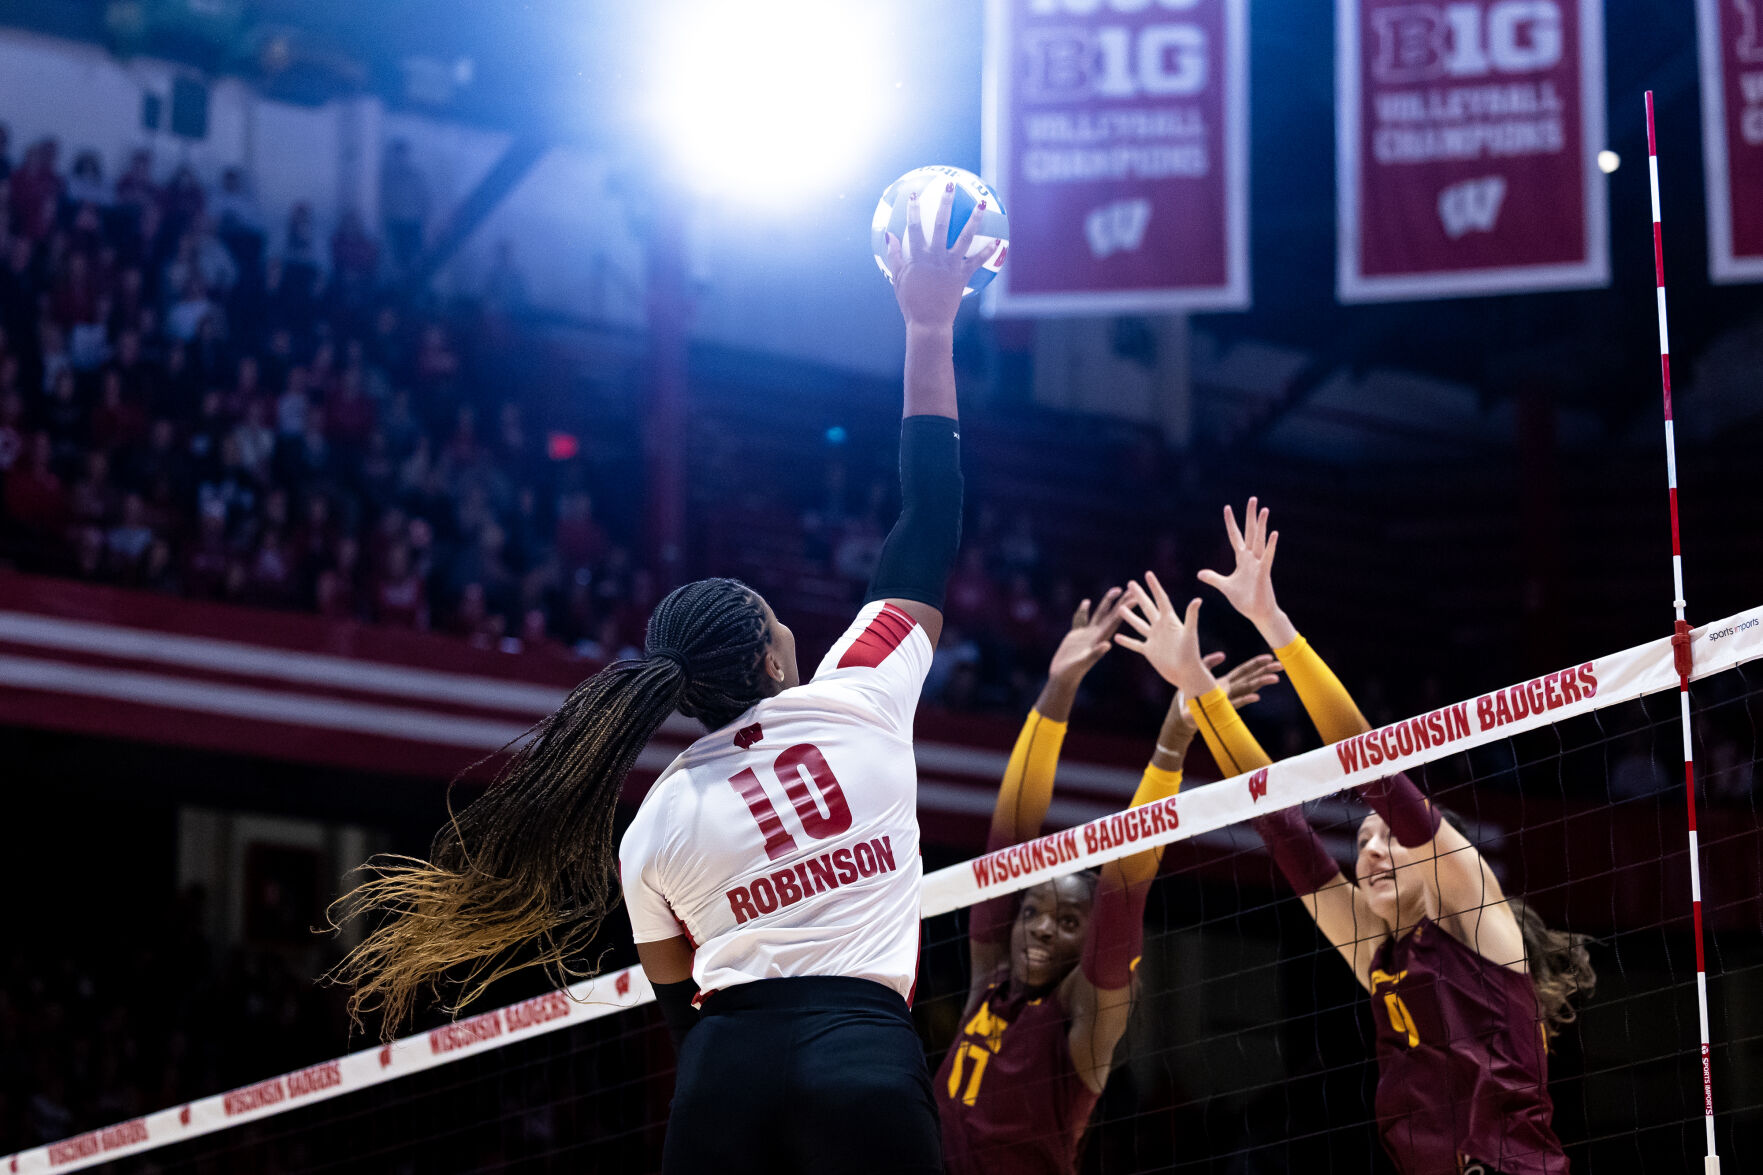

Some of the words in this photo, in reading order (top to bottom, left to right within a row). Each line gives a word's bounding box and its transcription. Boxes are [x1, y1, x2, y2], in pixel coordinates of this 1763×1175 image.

[1374, 79, 1561, 124] VOLLEYBALL
[1023, 144, 1209, 184] CHAMPIONS
[1372, 118, 1563, 166] CHAMPIONS
[1709, 627, 1734, 642] sports
[1336, 702, 1471, 775] WISCONSIN
[1477, 662, 1598, 732] BADGERS
[727, 743, 853, 861] 10
[972, 828, 1080, 889] WISCONSIN
[1083, 797, 1179, 855] BADGERS
[726, 835, 897, 925] ROBINSON
[430, 1010, 502, 1055] WISCONSIN
[504, 991, 570, 1033] BADGERS
[947, 1041, 990, 1106] 17
[1702, 1057, 1710, 1084] SPORTS
[1704, 1084, 1713, 1116] IMPORTS
